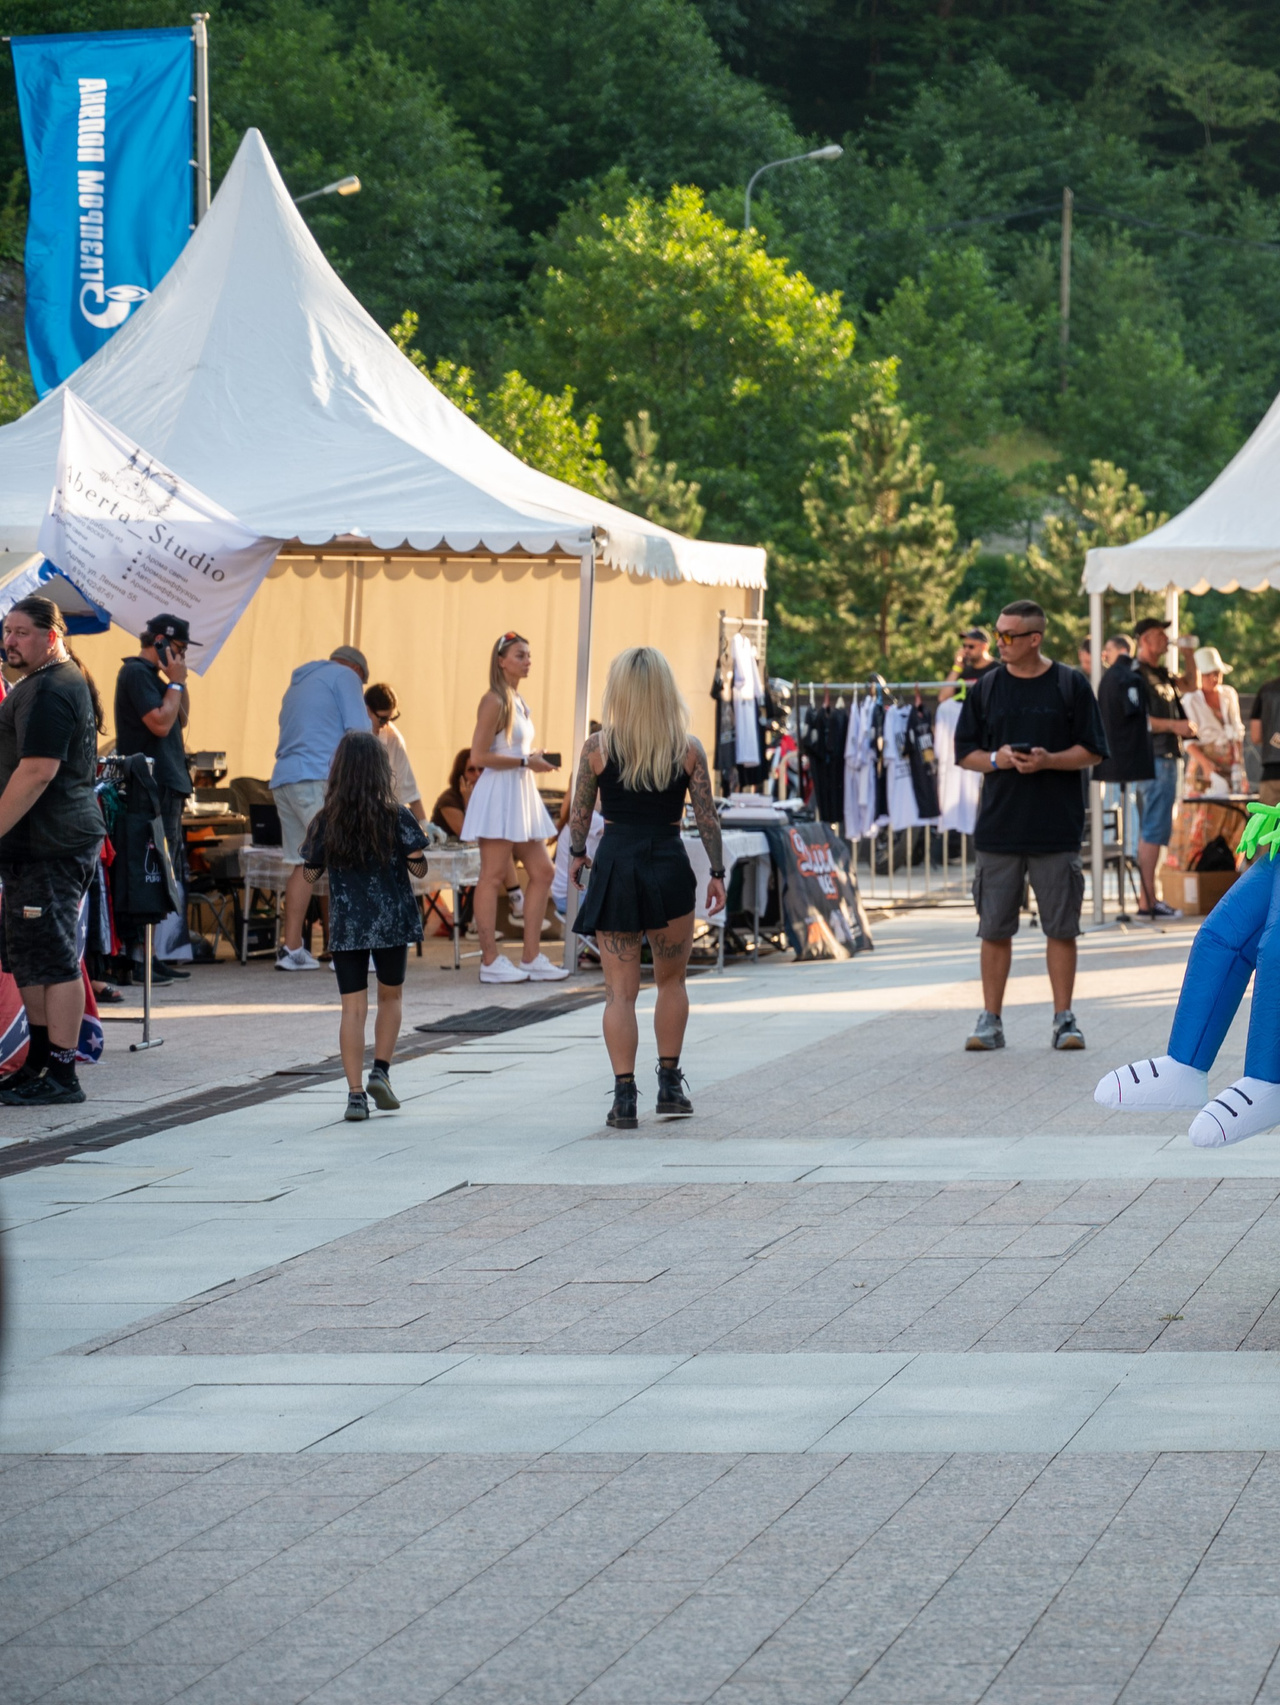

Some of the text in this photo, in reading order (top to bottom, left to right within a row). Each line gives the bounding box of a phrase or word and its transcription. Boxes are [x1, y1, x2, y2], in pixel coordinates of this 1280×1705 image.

[139, 562, 201, 604] Аромадиффузоры
[145, 553, 189, 584] Арома свечи
[99, 573, 127, 596] Ленина
[127, 592, 138, 602] 55
[129, 578, 170, 606] Аромасаше
[134, 570, 192, 609] Авто диффузоры
